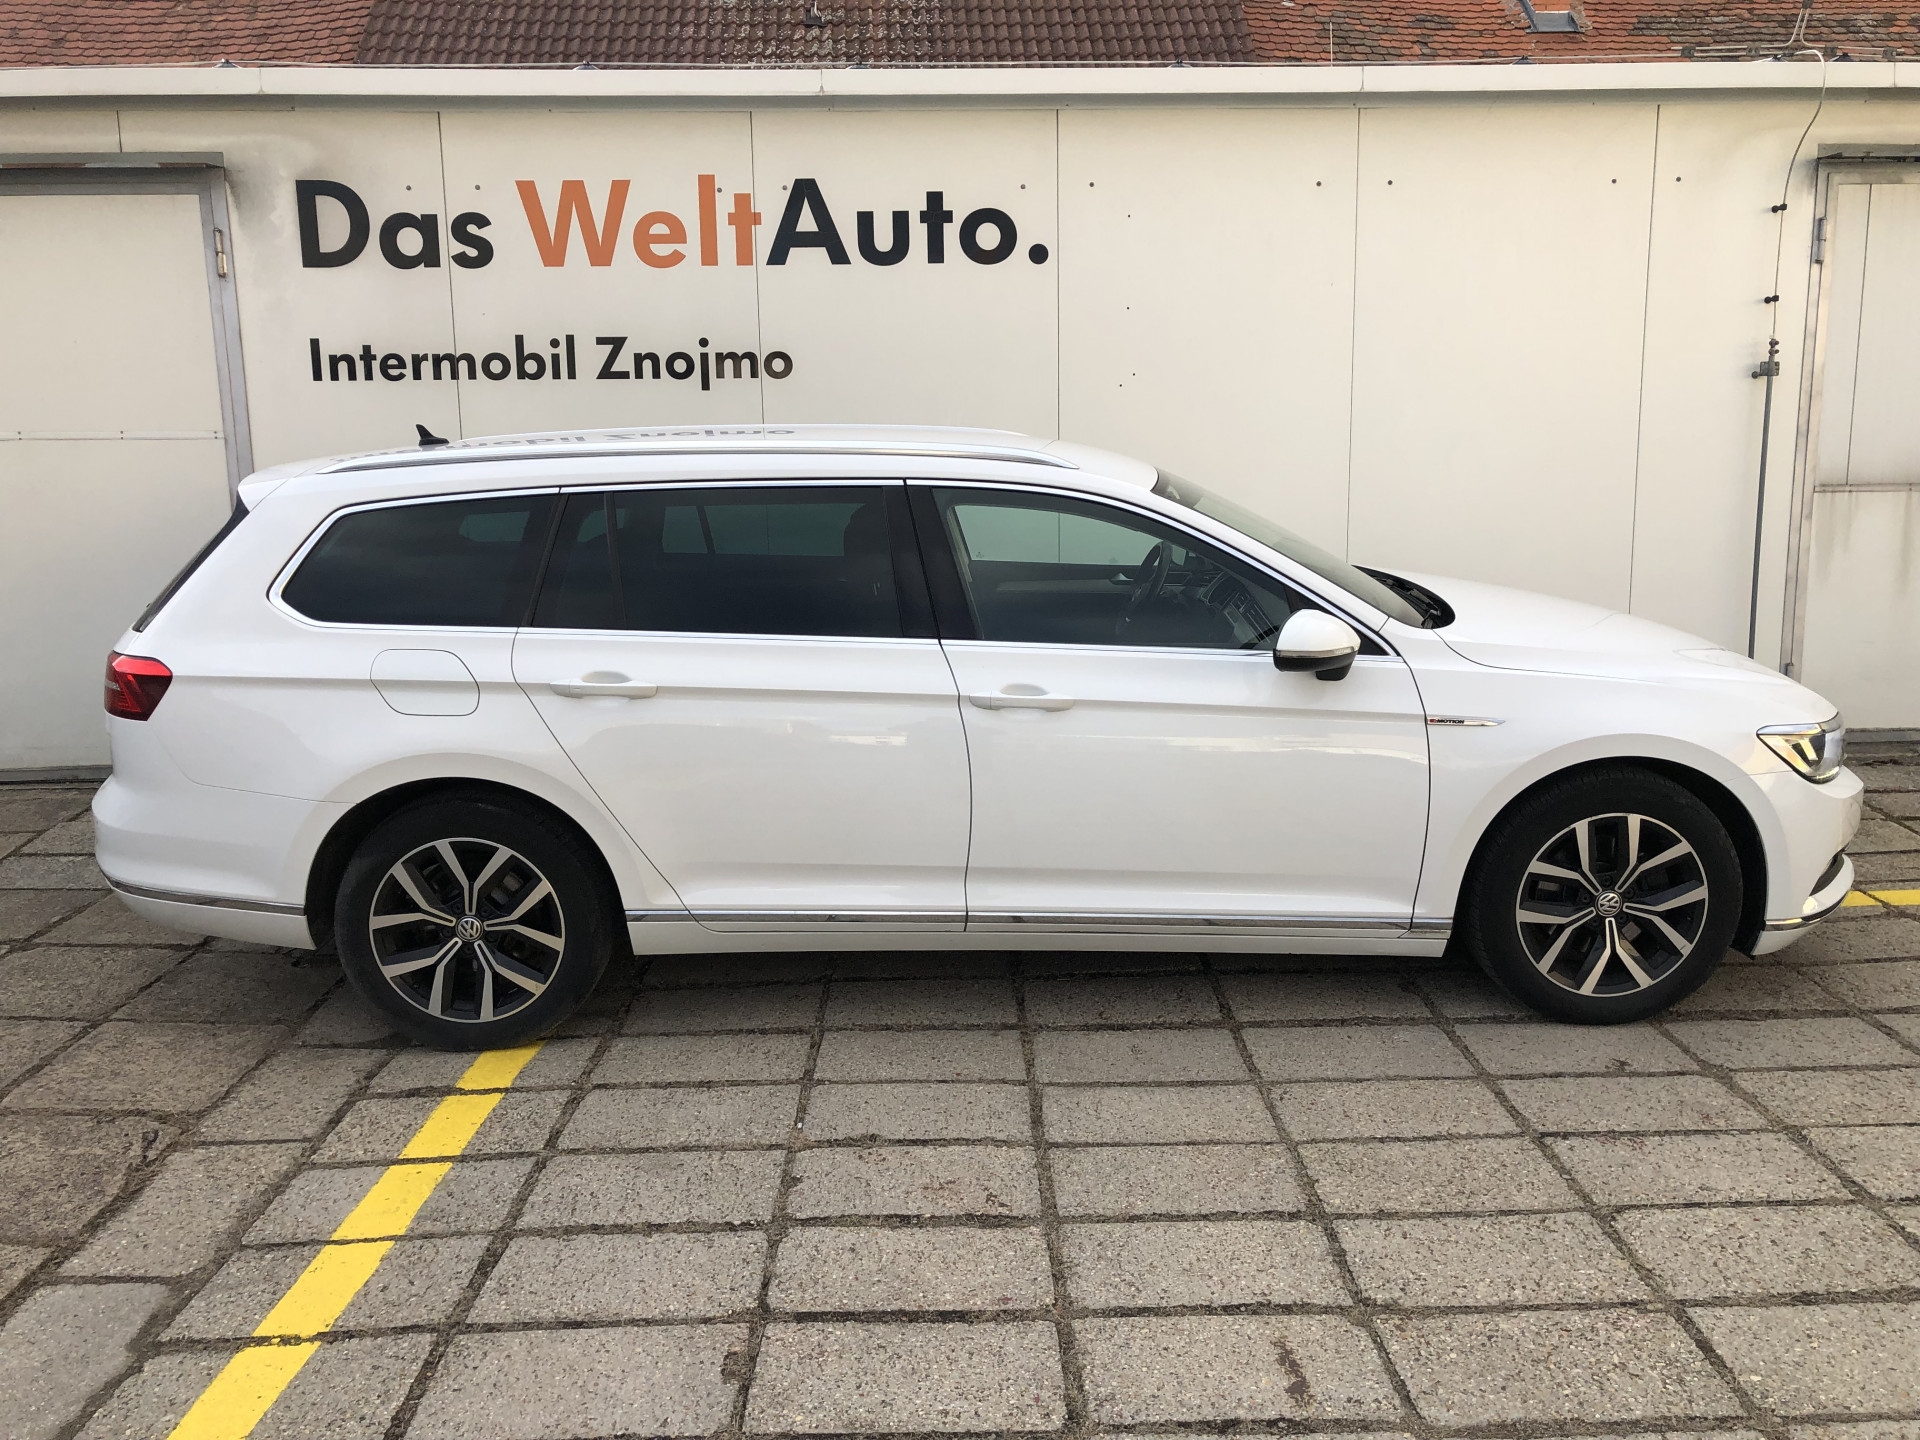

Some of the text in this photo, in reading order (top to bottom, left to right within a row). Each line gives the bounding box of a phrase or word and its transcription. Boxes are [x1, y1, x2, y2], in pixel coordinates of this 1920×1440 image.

[295, 174, 1049, 270] Das WeltAuto.
[309, 334, 794, 392] Intermobil Znojmo
